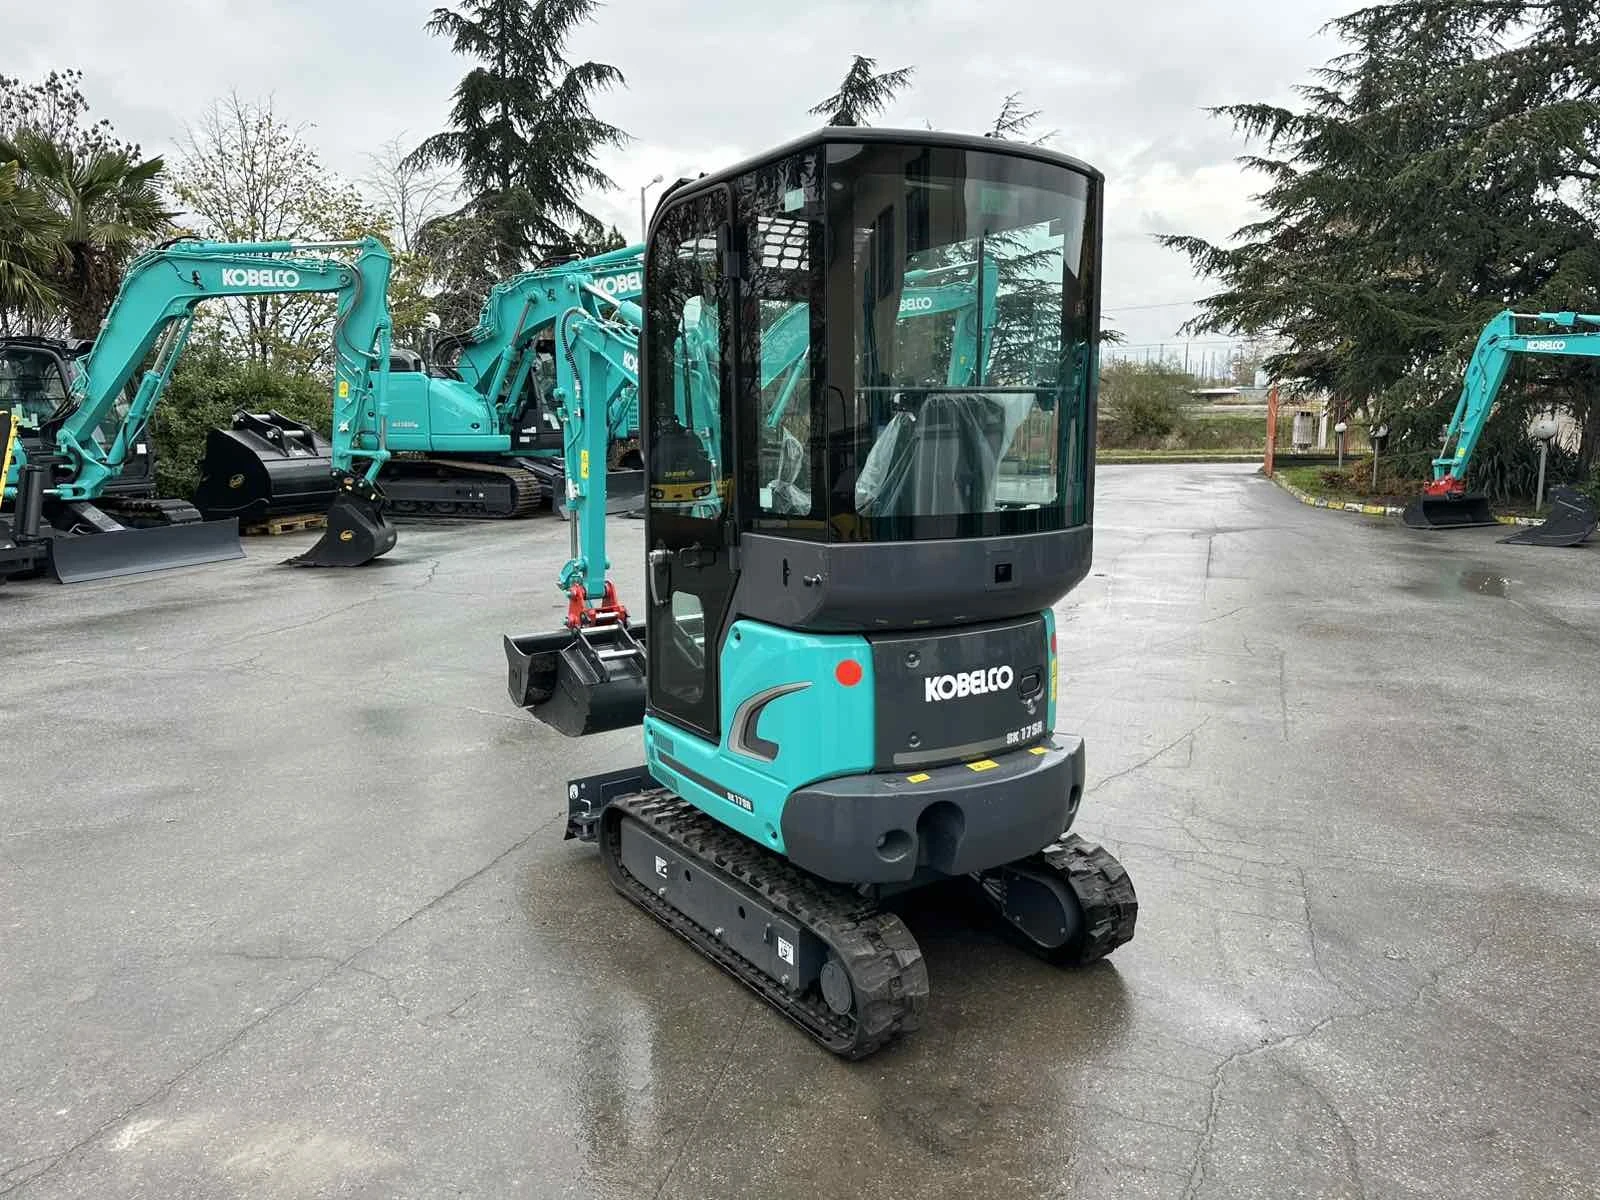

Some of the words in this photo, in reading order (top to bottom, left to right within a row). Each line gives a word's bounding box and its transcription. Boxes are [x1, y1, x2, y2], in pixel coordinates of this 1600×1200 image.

[222, 268, 300, 287] KOBELCO
[1526, 340, 1566, 351] KOBELCO
[925, 665, 1014, 702] KOBELCO
